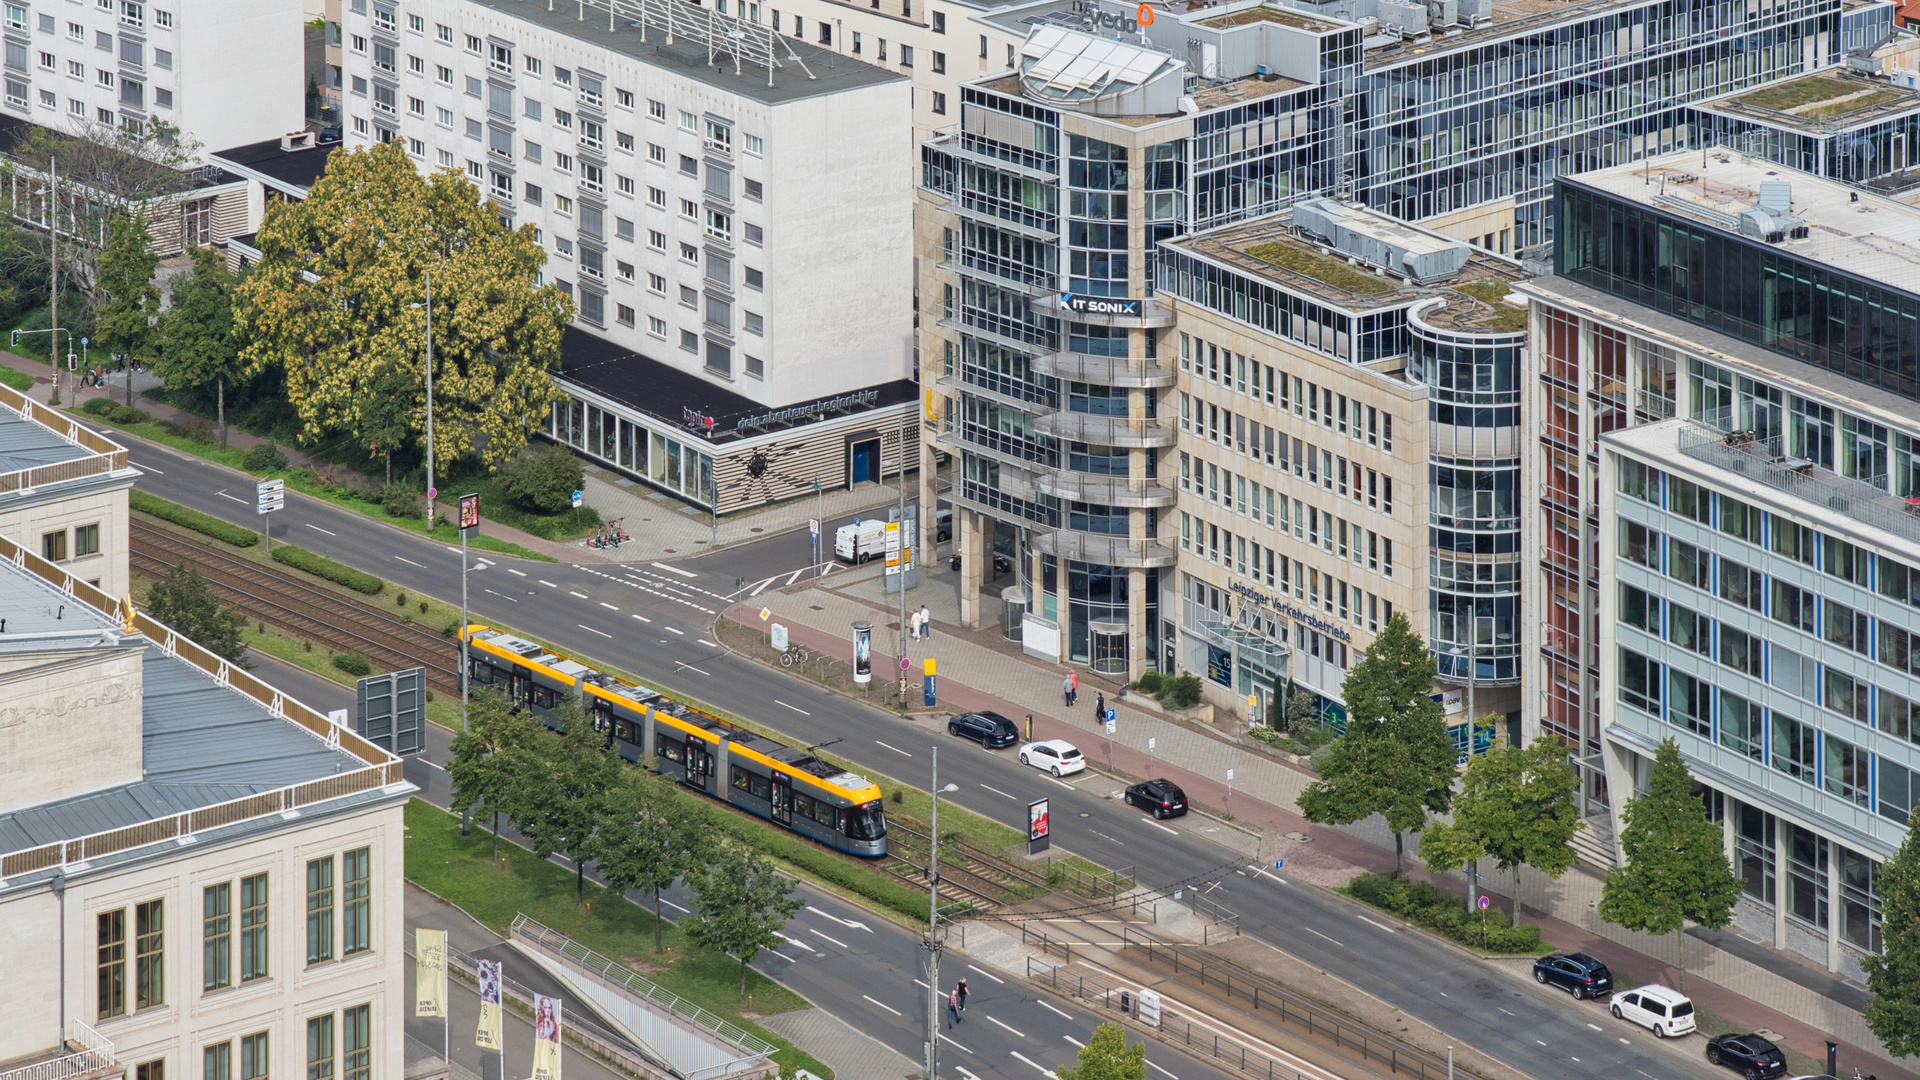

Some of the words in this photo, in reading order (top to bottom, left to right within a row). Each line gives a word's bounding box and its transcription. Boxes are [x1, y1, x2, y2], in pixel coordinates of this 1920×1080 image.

[1073, 299, 1086, 310] IT
[1088, 301, 1136, 314] SONIX
[738, 415, 760, 430] dein
[762, 406, 817, 423] abenteuer
[817, 395, 858, 412] beginnt
[859, 390, 879, 404] hier
[1228, 576, 1270, 605] Leipziger
[1271, 595, 1352, 643] Verkehrsbetriebe
[1223, 657, 1231, 669] 15
[1108, 710, 1113, 720] P
